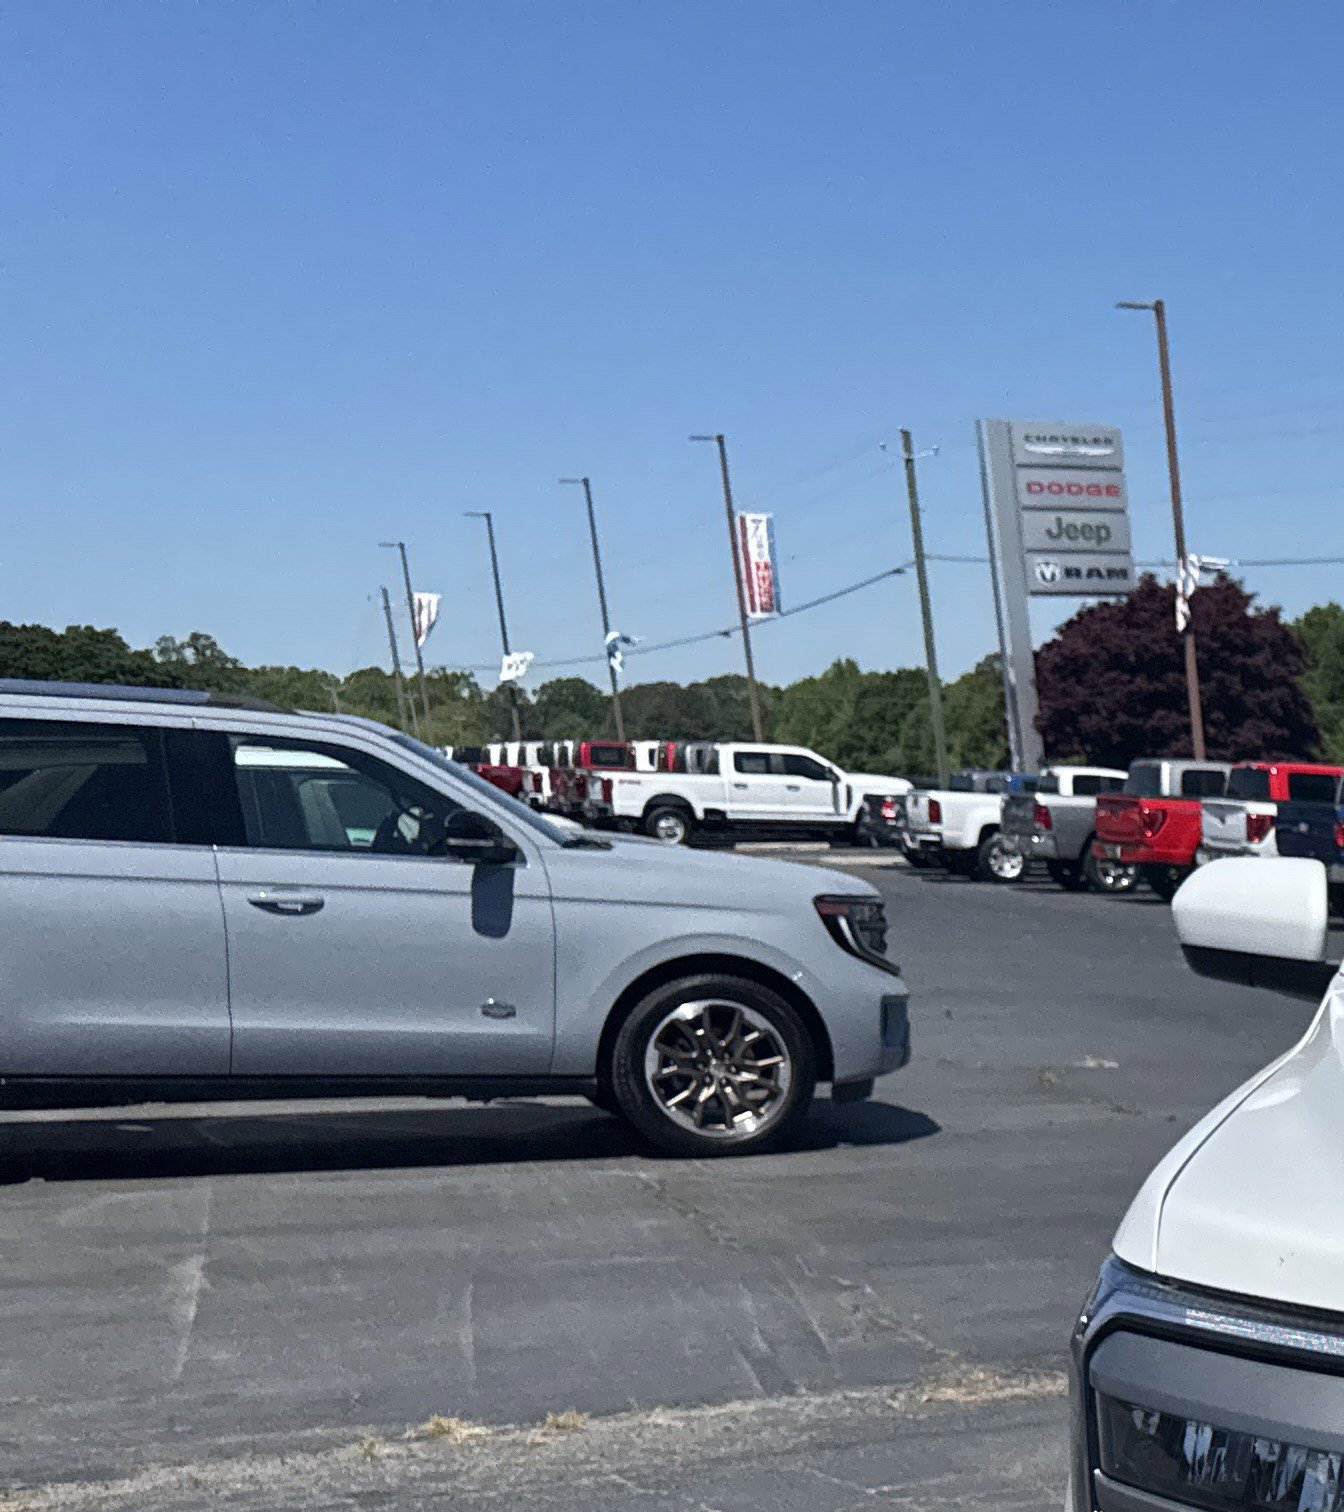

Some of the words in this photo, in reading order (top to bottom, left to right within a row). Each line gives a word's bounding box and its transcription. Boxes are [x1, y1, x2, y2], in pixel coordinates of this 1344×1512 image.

[1023, 434, 1113, 446] CHRYSLER
[1027, 481, 1120, 496] DODGE
[1046, 516, 1112, 545] Jeep
[1064, 566, 1129, 580] RAM
